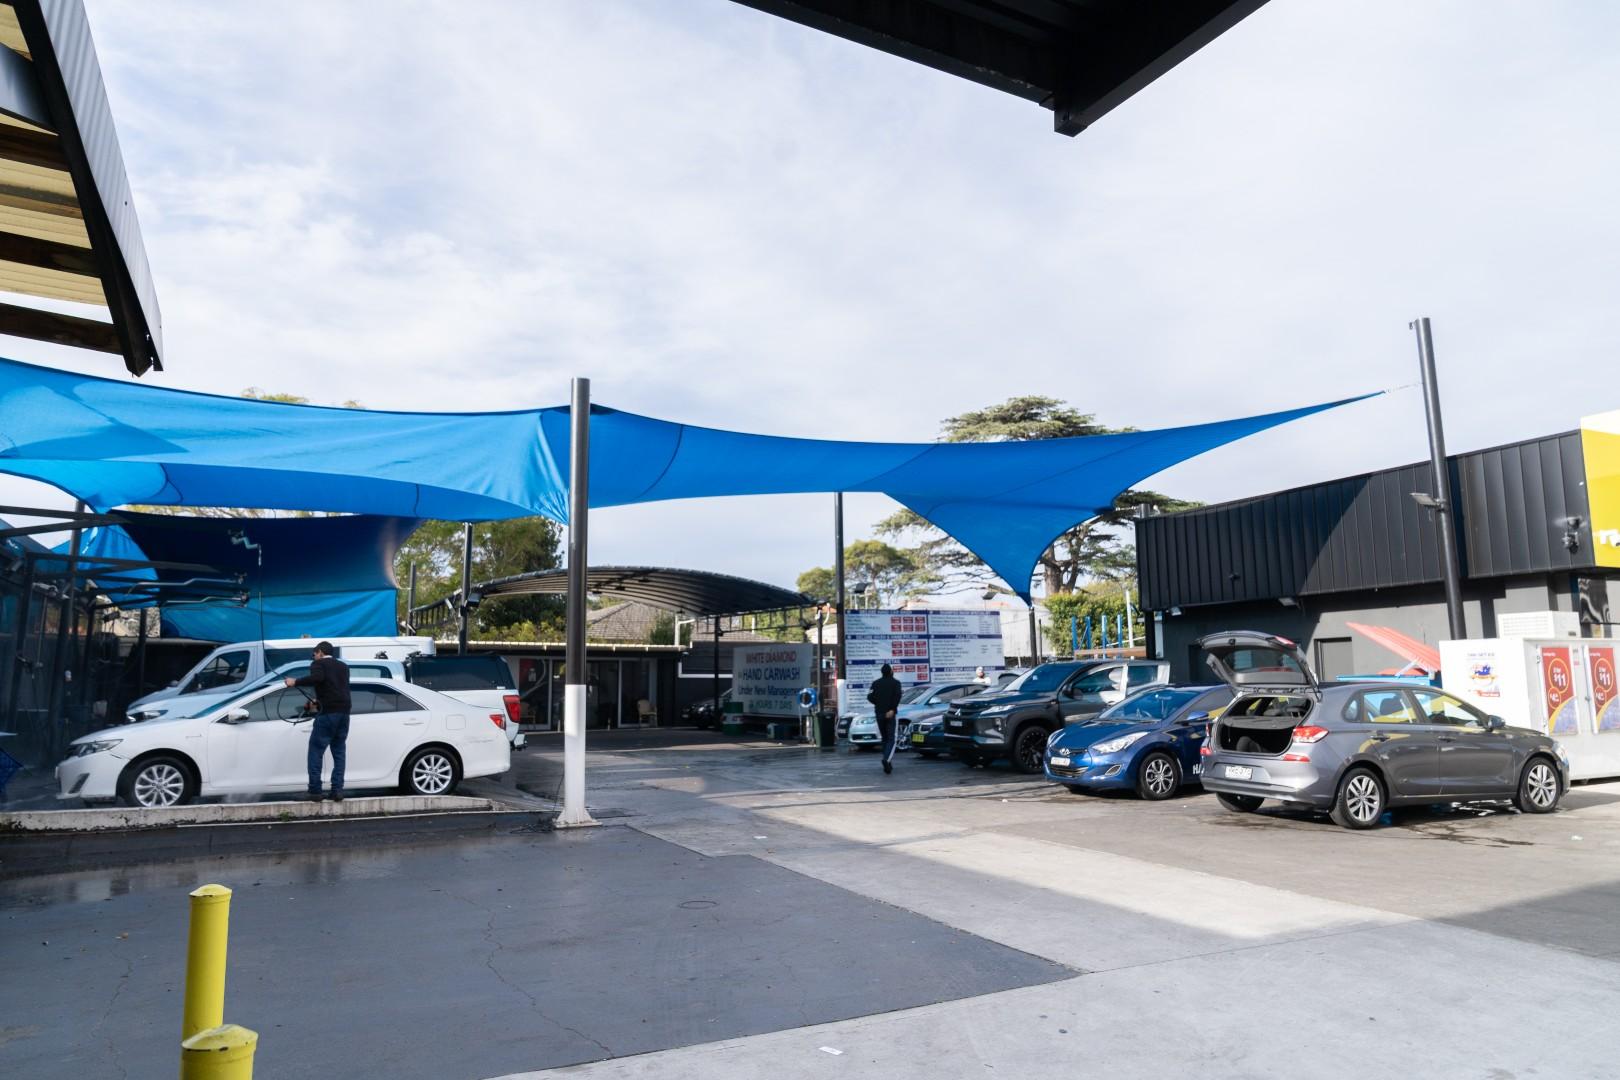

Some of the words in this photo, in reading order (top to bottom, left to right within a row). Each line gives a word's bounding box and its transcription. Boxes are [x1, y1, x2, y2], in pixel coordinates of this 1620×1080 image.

[765, 651, 796, 663] DIAMOND
[743, 668, 762, 680] HAND
[764, 667, 800, 680] CARWASH
[738, 686, 753, 696] Under
[754, 685, 766, 696] New
